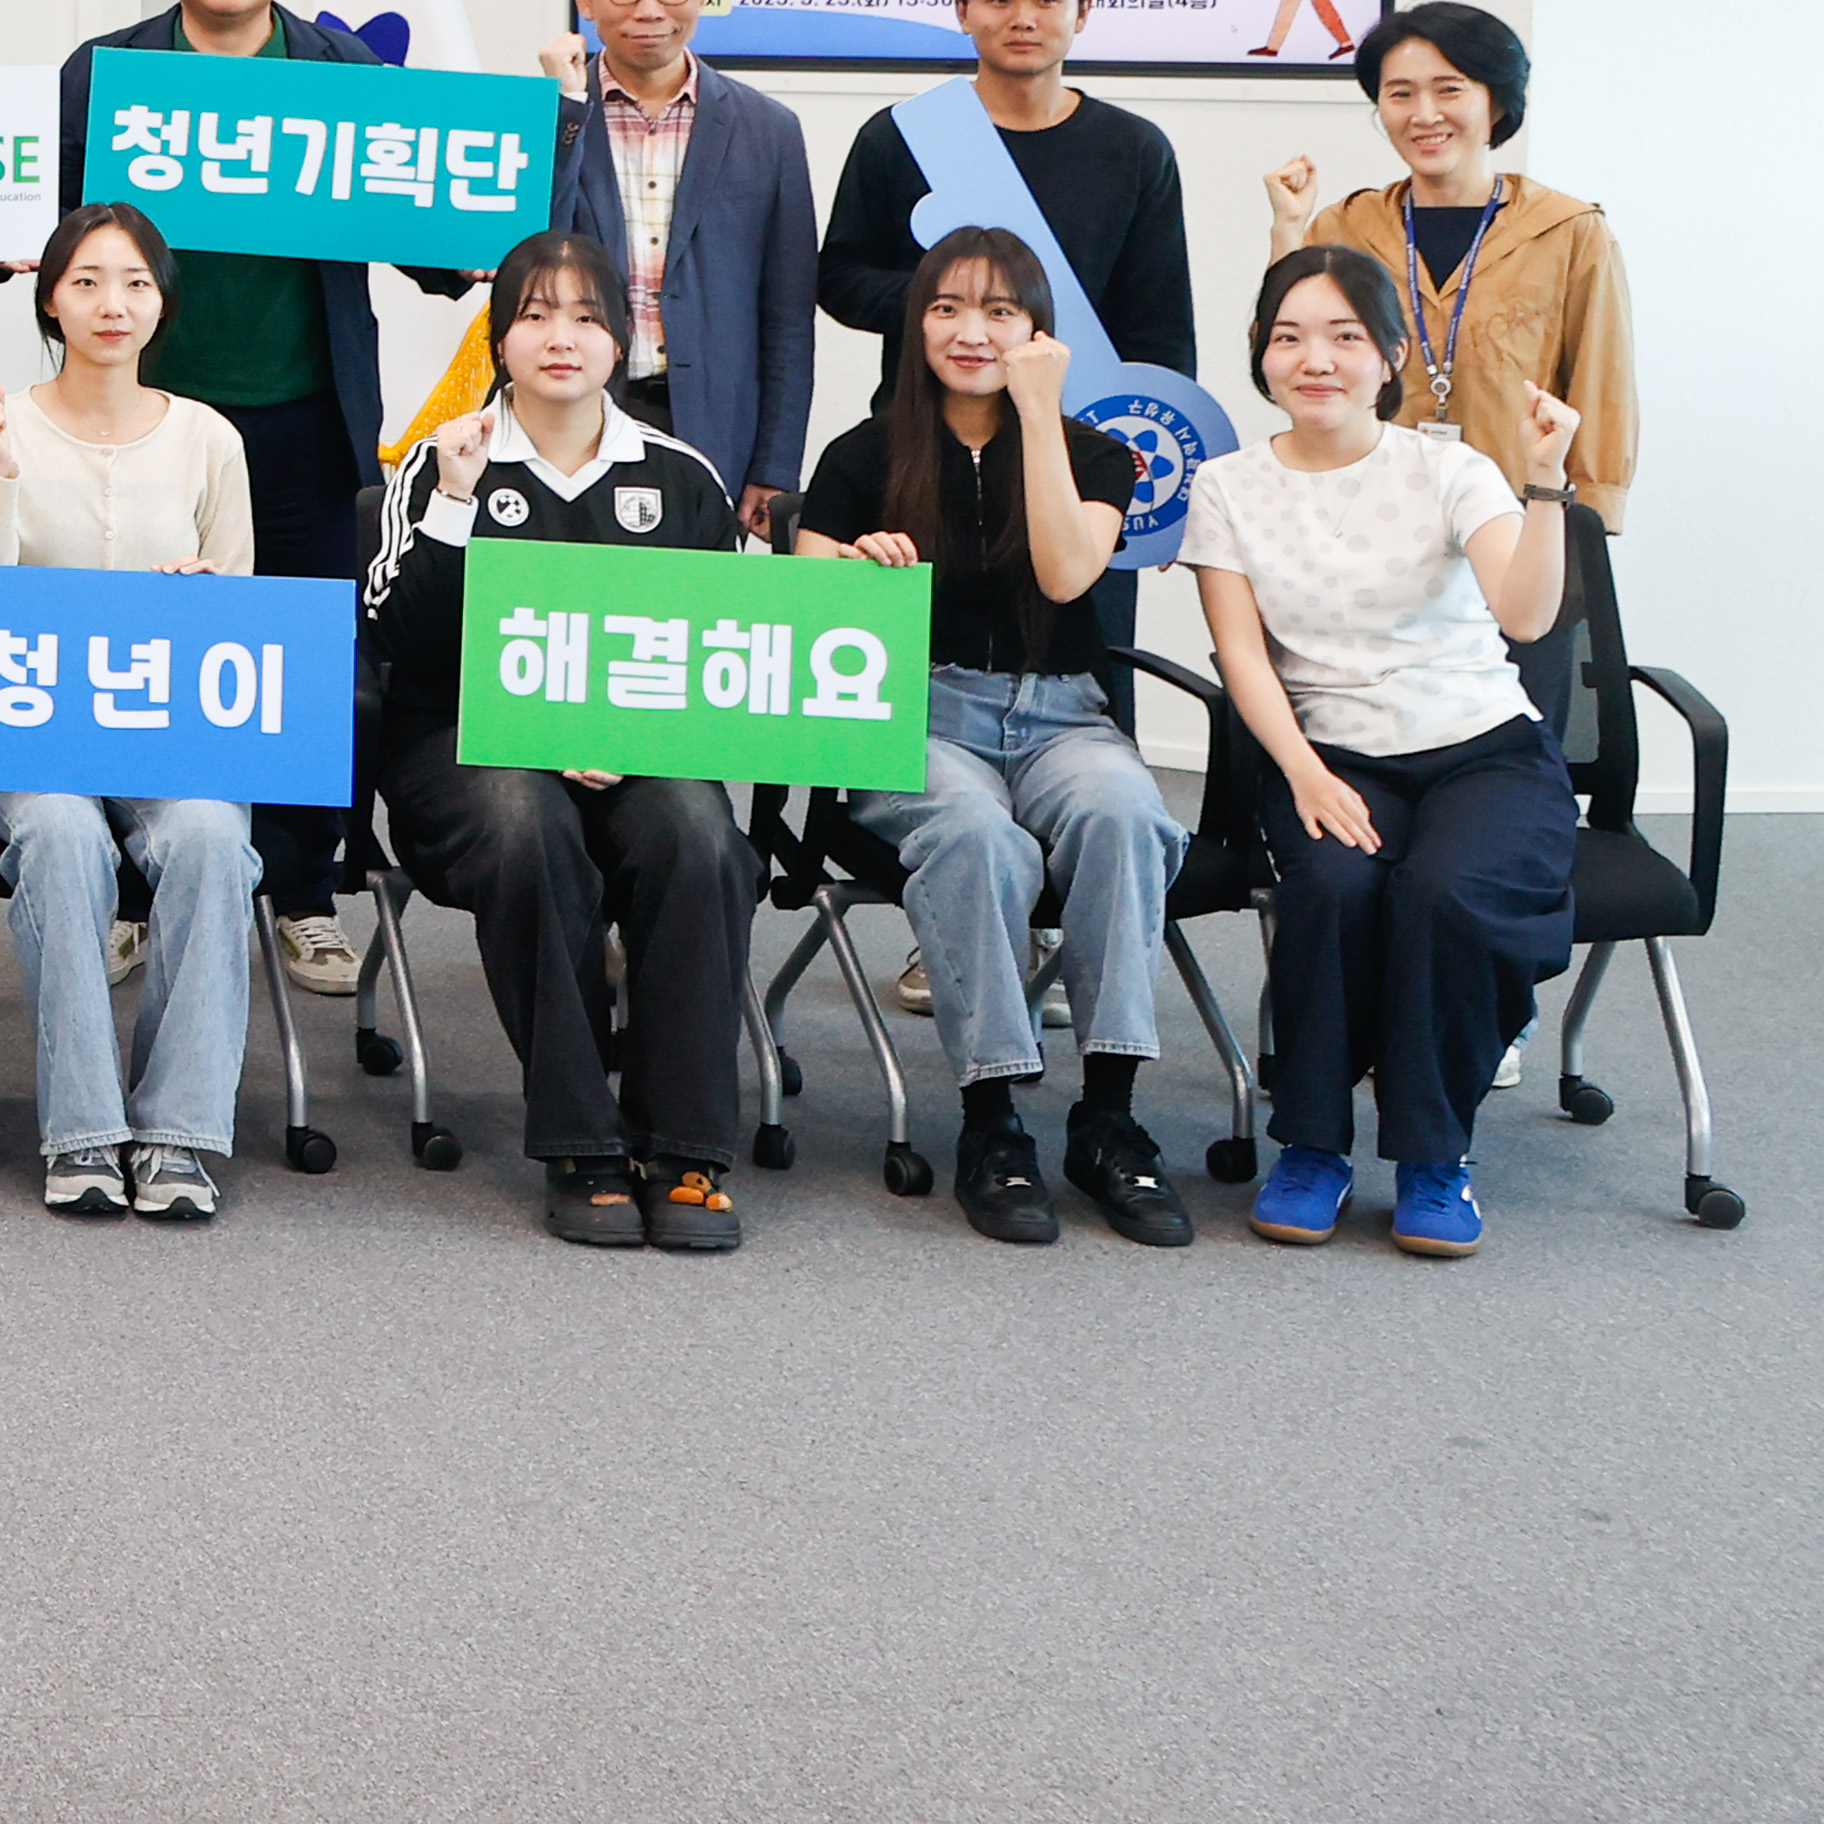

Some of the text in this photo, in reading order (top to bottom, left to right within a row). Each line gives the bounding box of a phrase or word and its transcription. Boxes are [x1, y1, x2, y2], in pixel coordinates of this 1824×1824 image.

[110, 103, 530, 213] 청년기획단
[1127, 398, 1177, 426] 유성구
[497, 604, 895, 722] 해결해요
